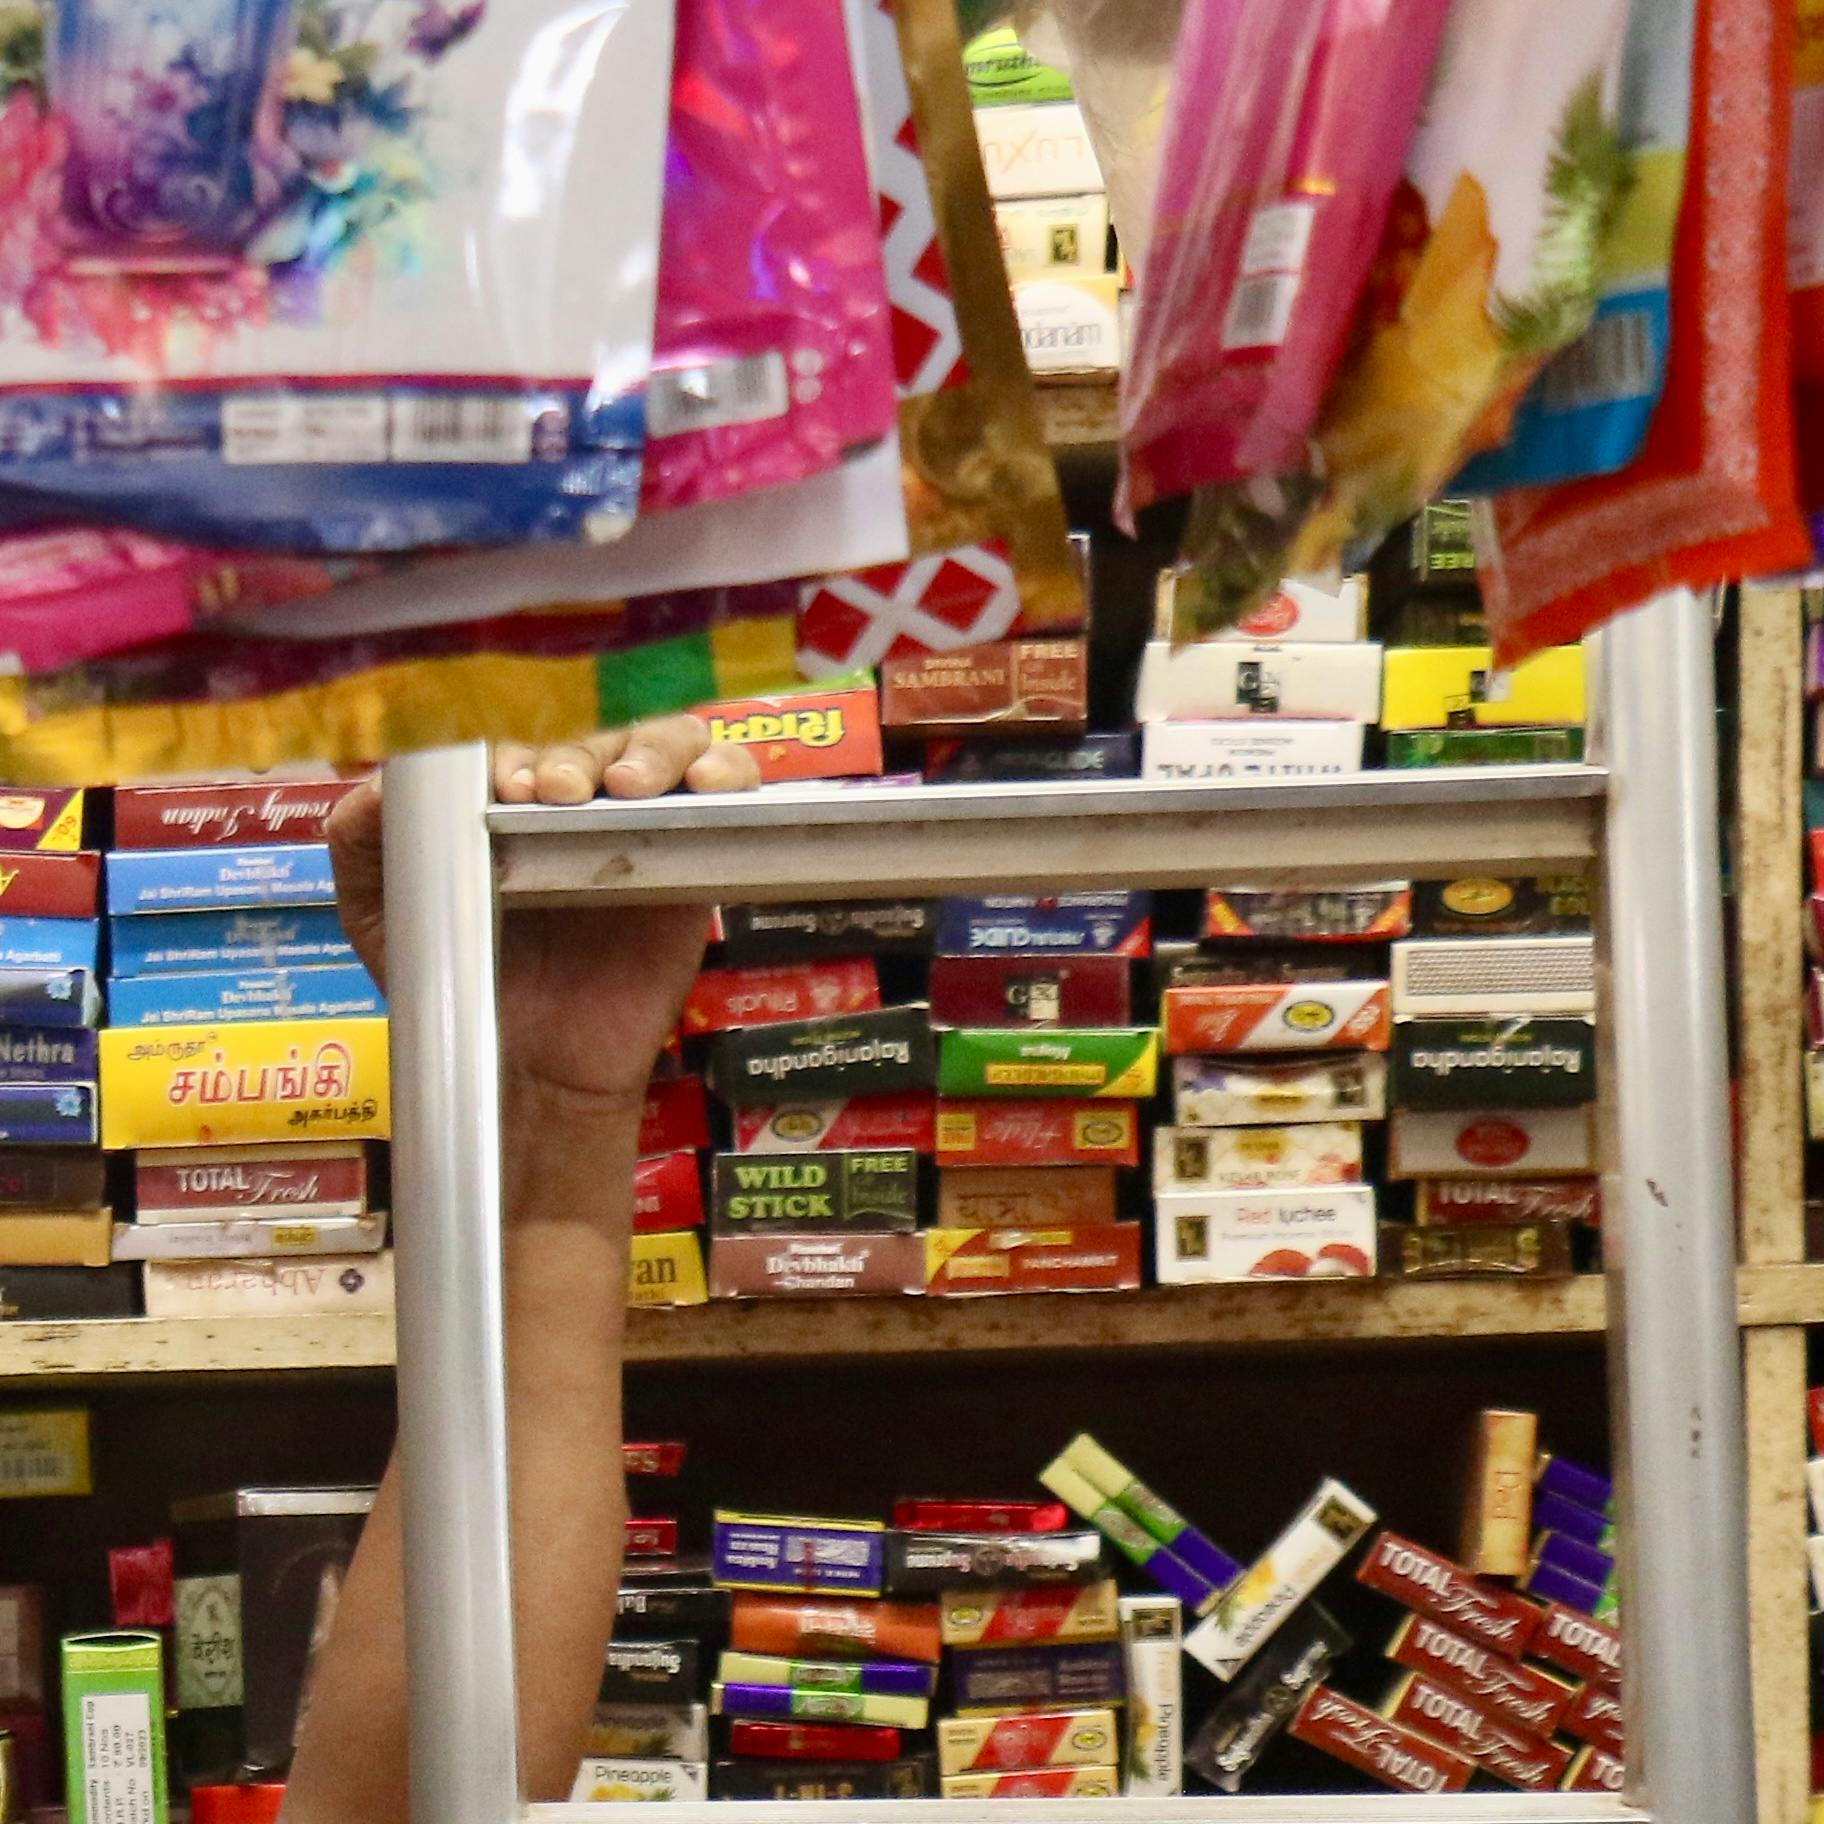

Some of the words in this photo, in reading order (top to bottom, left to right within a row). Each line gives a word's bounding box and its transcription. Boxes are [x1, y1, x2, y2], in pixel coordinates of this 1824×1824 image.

[1019, 644, 1078, 660] FREE
[160, 804, 255, 841] Indian
[169, 1041, 353, 1106] சம்பங்கி
[747, 1041, 910, 1079] Rajanigandha
[1411, 1047, 1582, 1076] Rajanigandha
[735, 1165, 828, 1190] WILD
[851, 1156, 910, 1175] FREE
[175, 1166, 250, 1194] TOTAL
[235, 1173, 320, 1203] Fresh
[728, 1195, 836, 1220] STICK
[1278, 1203, 1337, 1227] lychee
[1378, 1541, 1456, 1597] TOTAL
[1444, 1588, 1523, 1647] Fresh
[1412, 1623, 1488, 1677] TOTAL
[1476, 1661, 1559, 1728] Fresh
[1309, 1694, 1382, 1750] Fresh
[1409, 1681, 1485, 1741] TOTAL
[1473, 1722, 1551, 1787] Fresh
[594, 1766, 672, 1784] Pineapple
[1375, 1740, 1449, 1792] TOTAL
